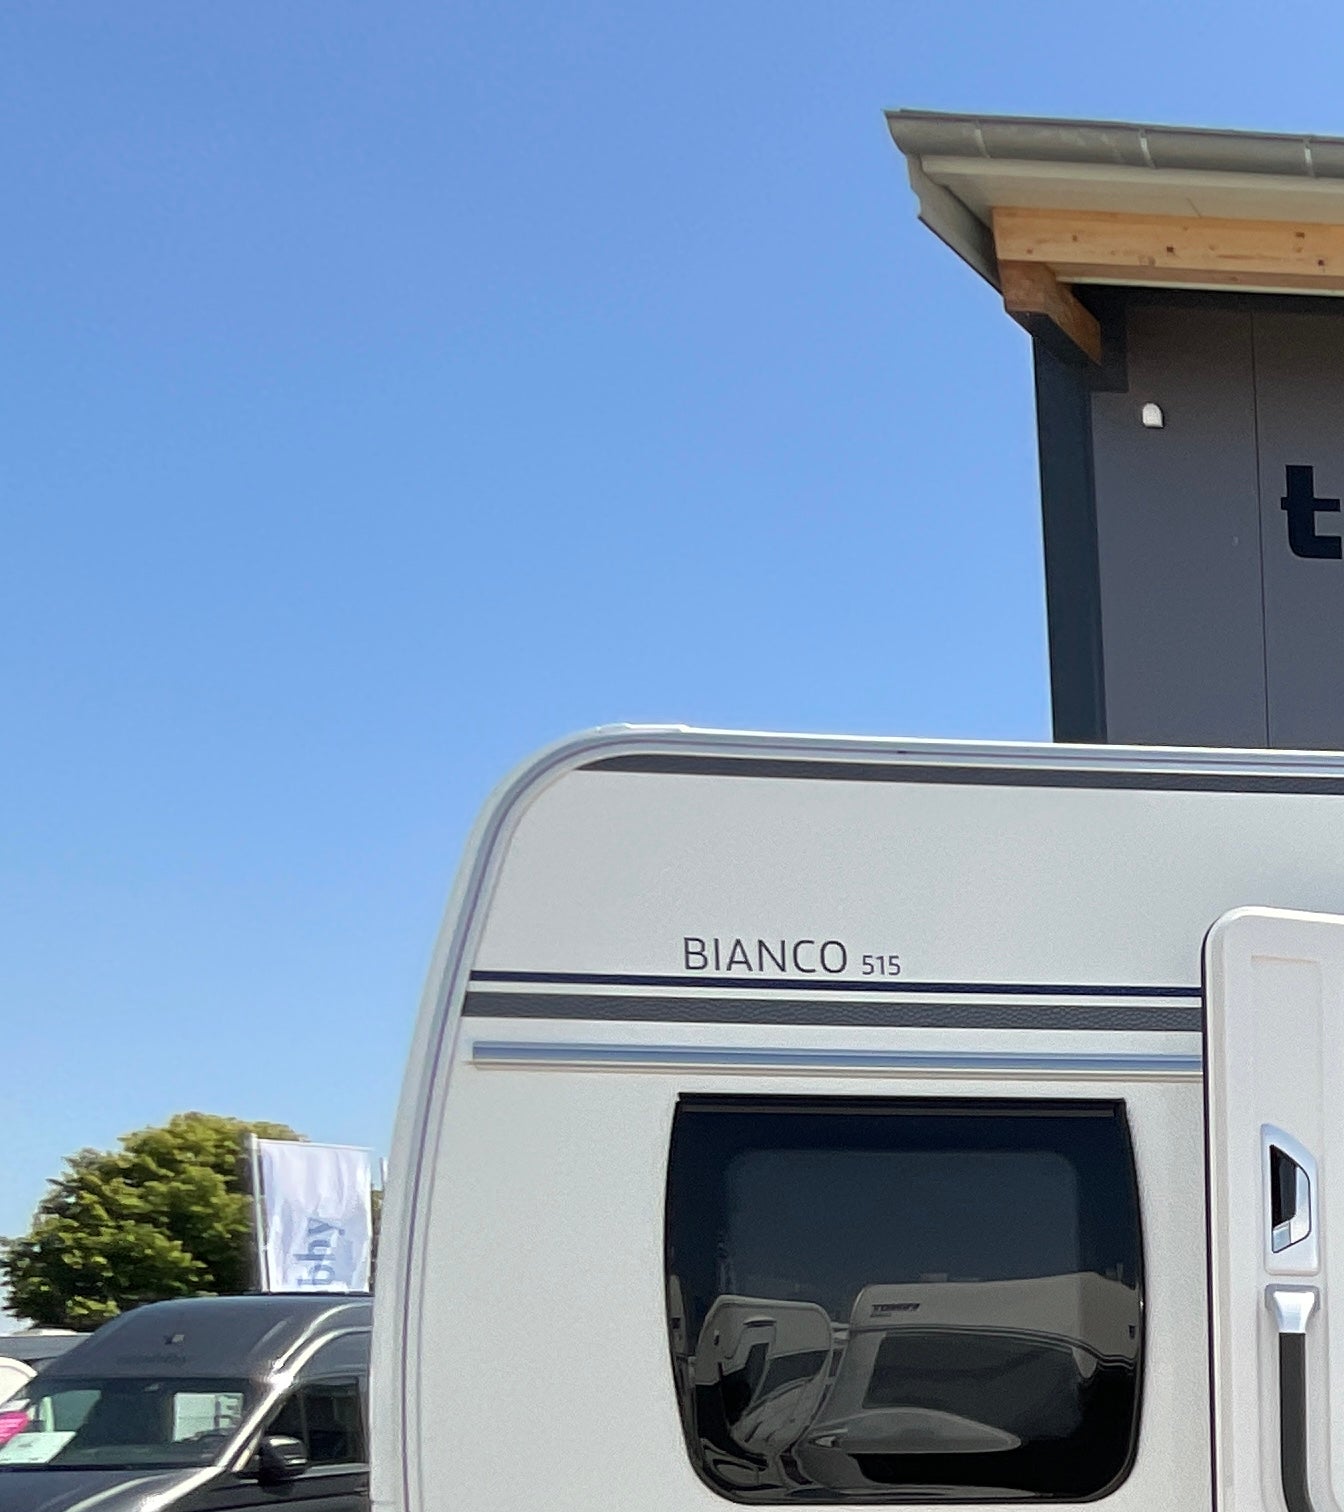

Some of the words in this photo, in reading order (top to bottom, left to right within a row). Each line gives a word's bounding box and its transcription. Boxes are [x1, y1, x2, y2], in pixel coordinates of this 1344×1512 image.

[683, 936, 848, 974] BIANCO
[862, 955, 901, 976] 515
[294, 1218, 345, 1286] bby
